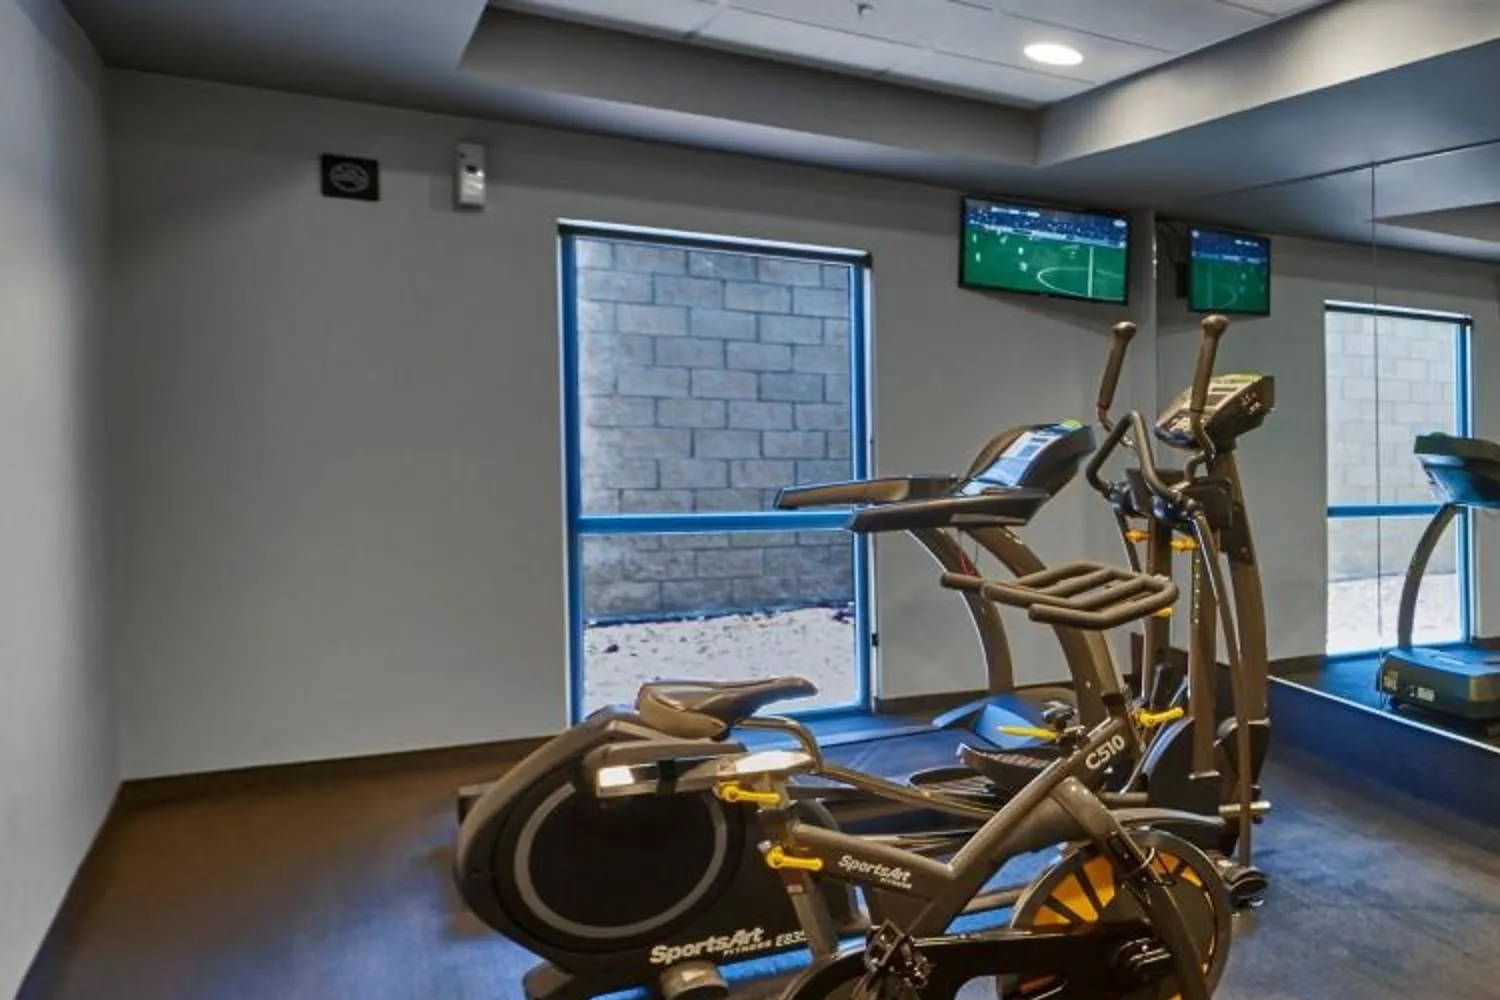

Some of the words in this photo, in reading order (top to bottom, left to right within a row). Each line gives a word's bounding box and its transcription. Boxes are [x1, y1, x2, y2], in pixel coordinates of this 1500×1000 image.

[1085, 735, 1125, 769] C510
[838, 854, 911, 882] SportsArt
[650, 927, 765, 965] SportsArt
